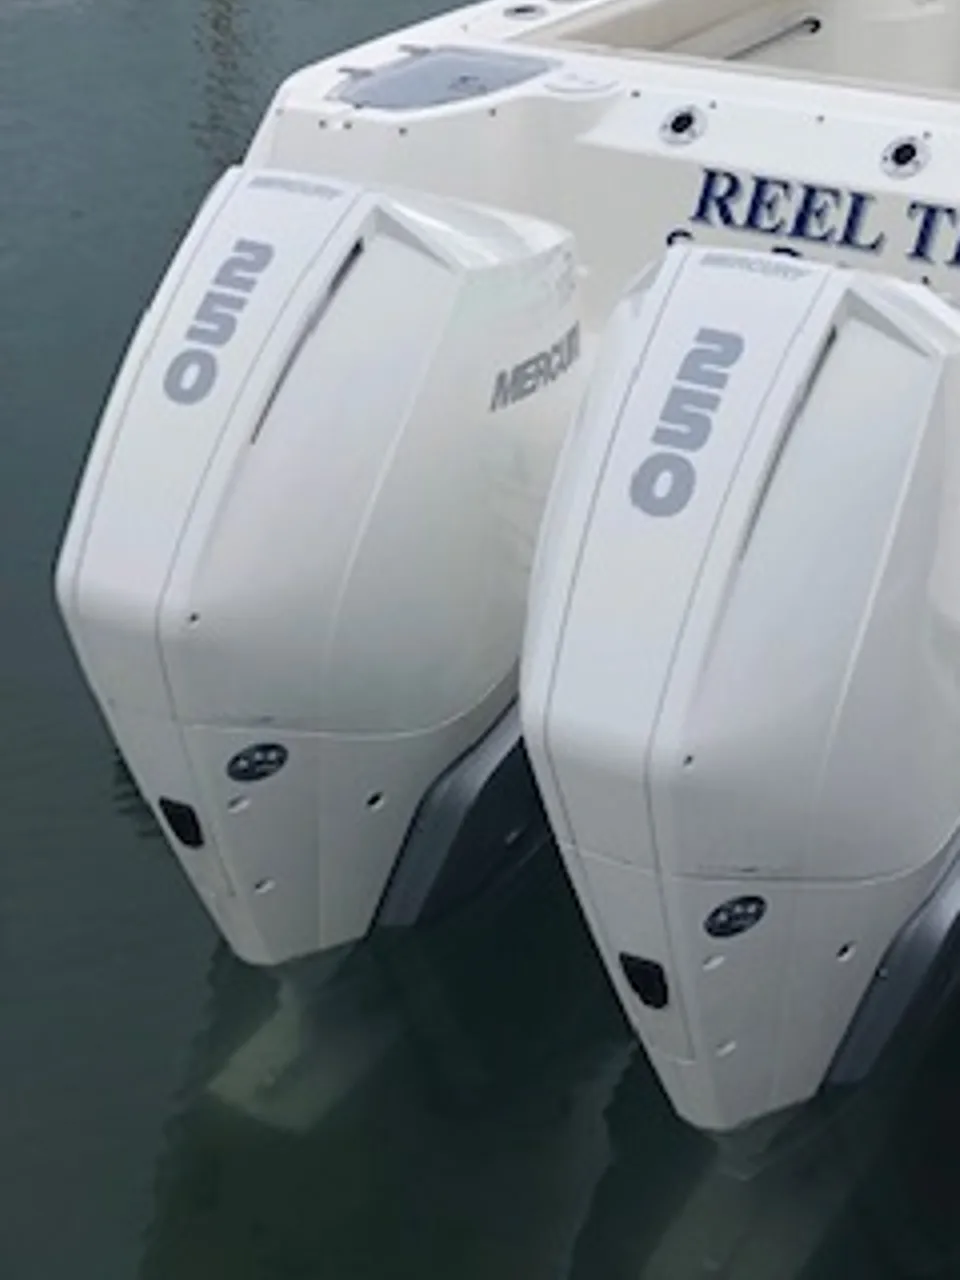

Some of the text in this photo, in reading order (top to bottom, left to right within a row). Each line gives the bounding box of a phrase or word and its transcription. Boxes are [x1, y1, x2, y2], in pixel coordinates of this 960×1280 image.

[688, 167, 886, 253] REEL
[163, 238, 275, 406] 250
[629, 326, 745, 518] 250
